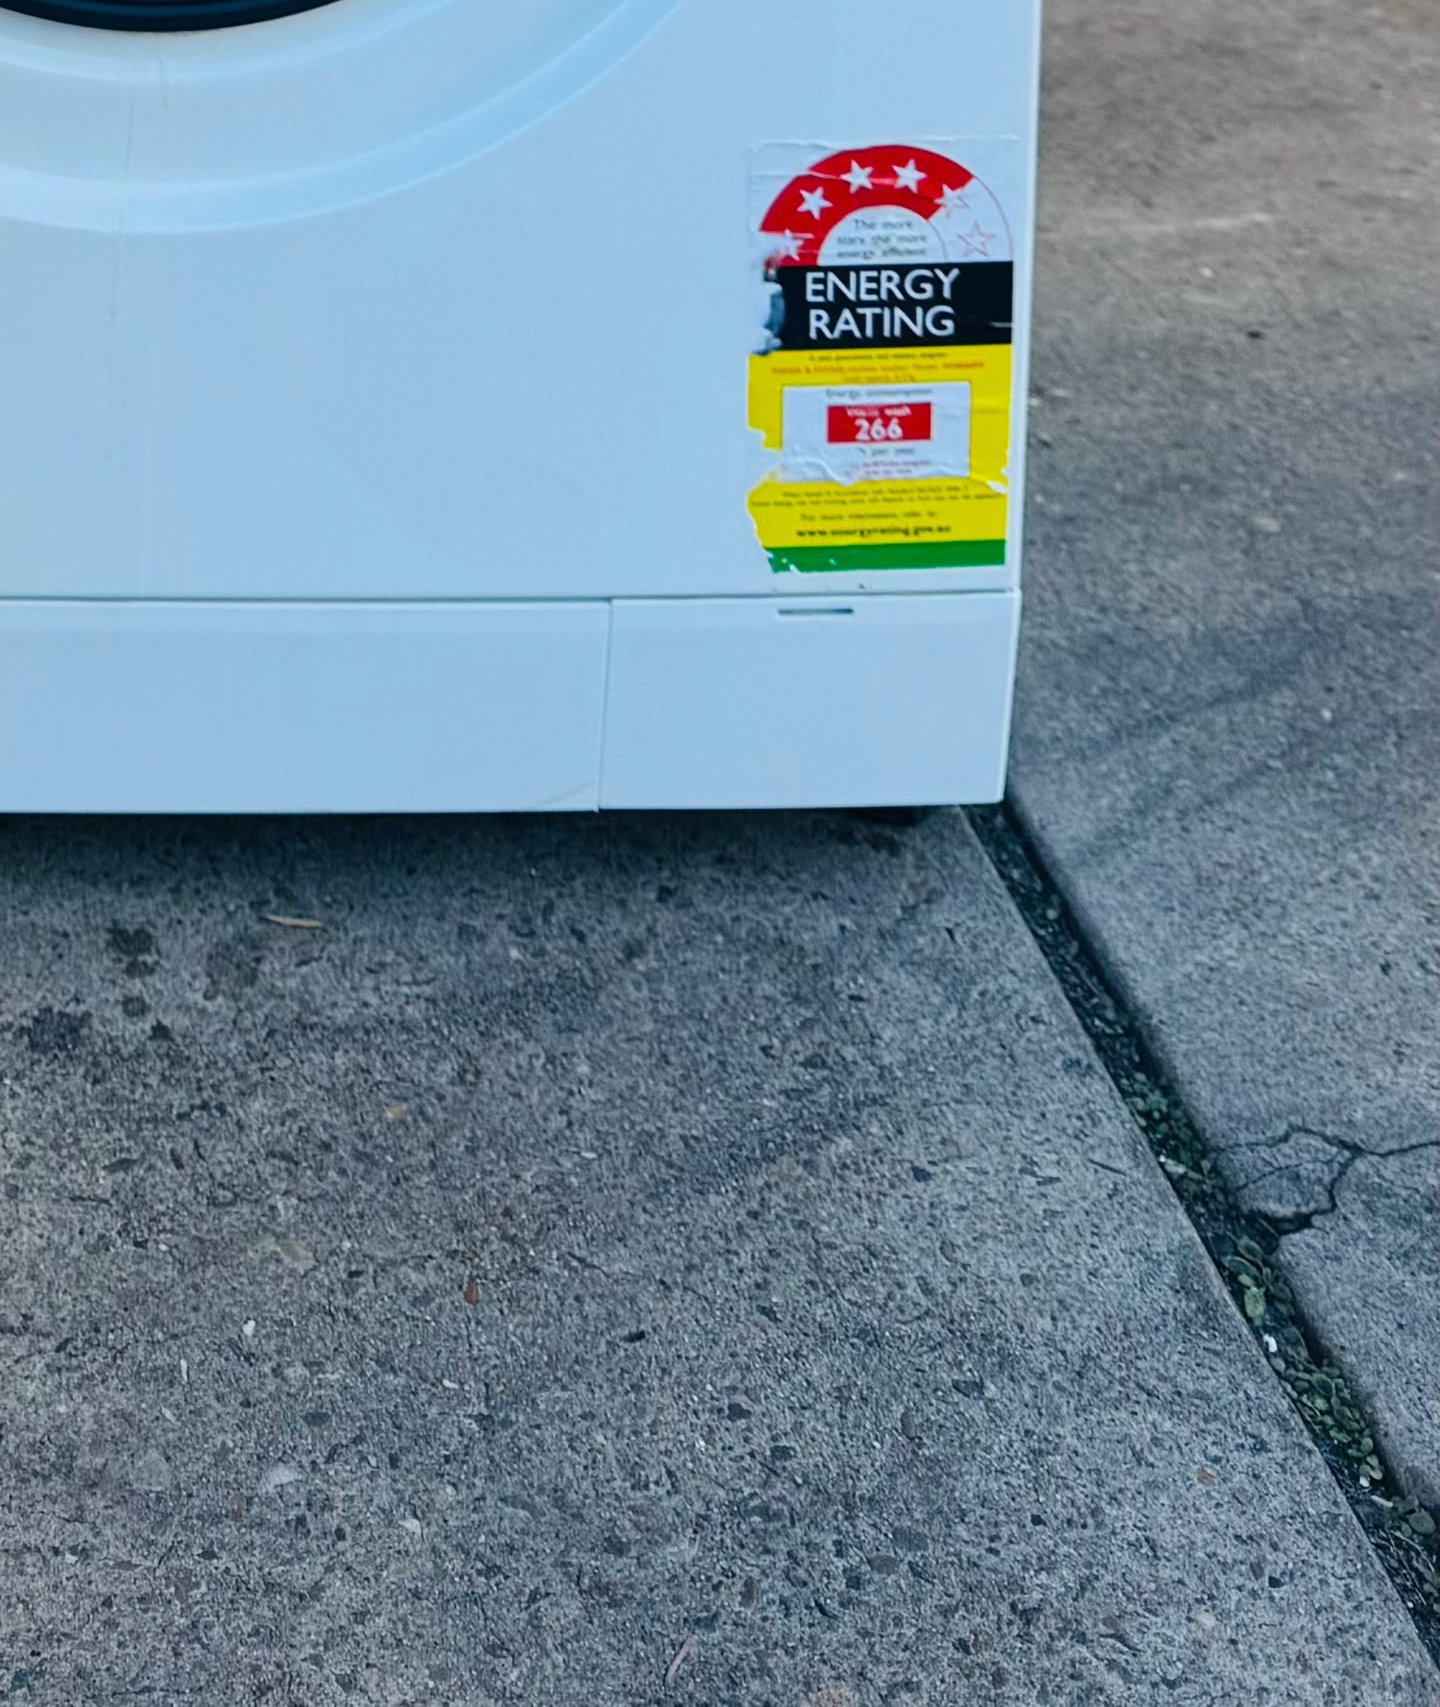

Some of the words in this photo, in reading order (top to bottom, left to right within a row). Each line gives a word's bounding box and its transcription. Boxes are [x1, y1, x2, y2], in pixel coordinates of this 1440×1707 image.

[806, 268, 959, 303] ENERGY
[809, 305, 955, 341] RATING
[854, 418, 903, 441] 266
